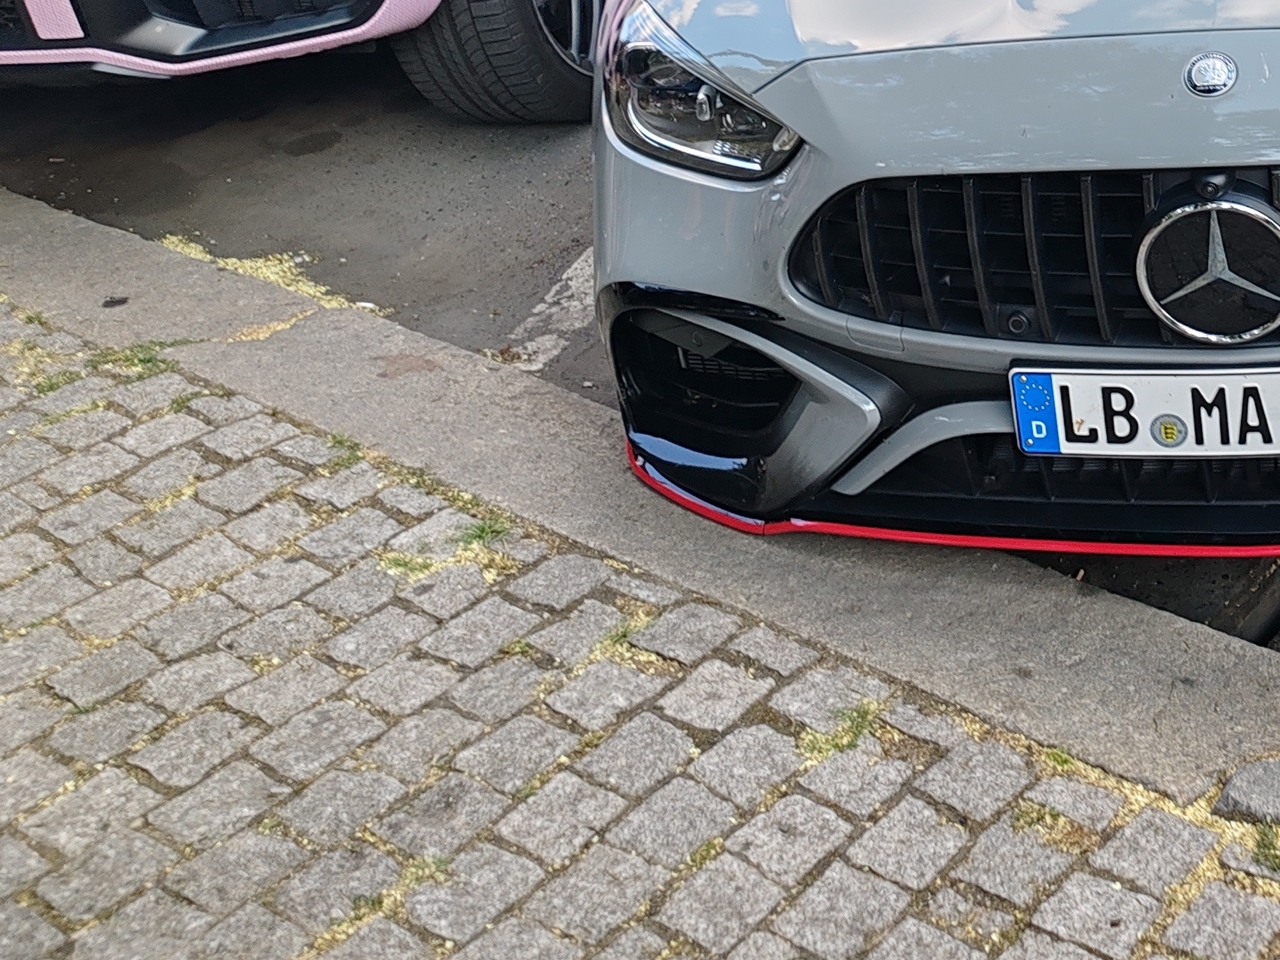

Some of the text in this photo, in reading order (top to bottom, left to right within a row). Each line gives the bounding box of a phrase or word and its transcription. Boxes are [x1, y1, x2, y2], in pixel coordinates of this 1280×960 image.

[1031, 419, 1047, 439] D
[1059, 385, 1139, 445] LB
[1191, 386, 1273, 445] MA
